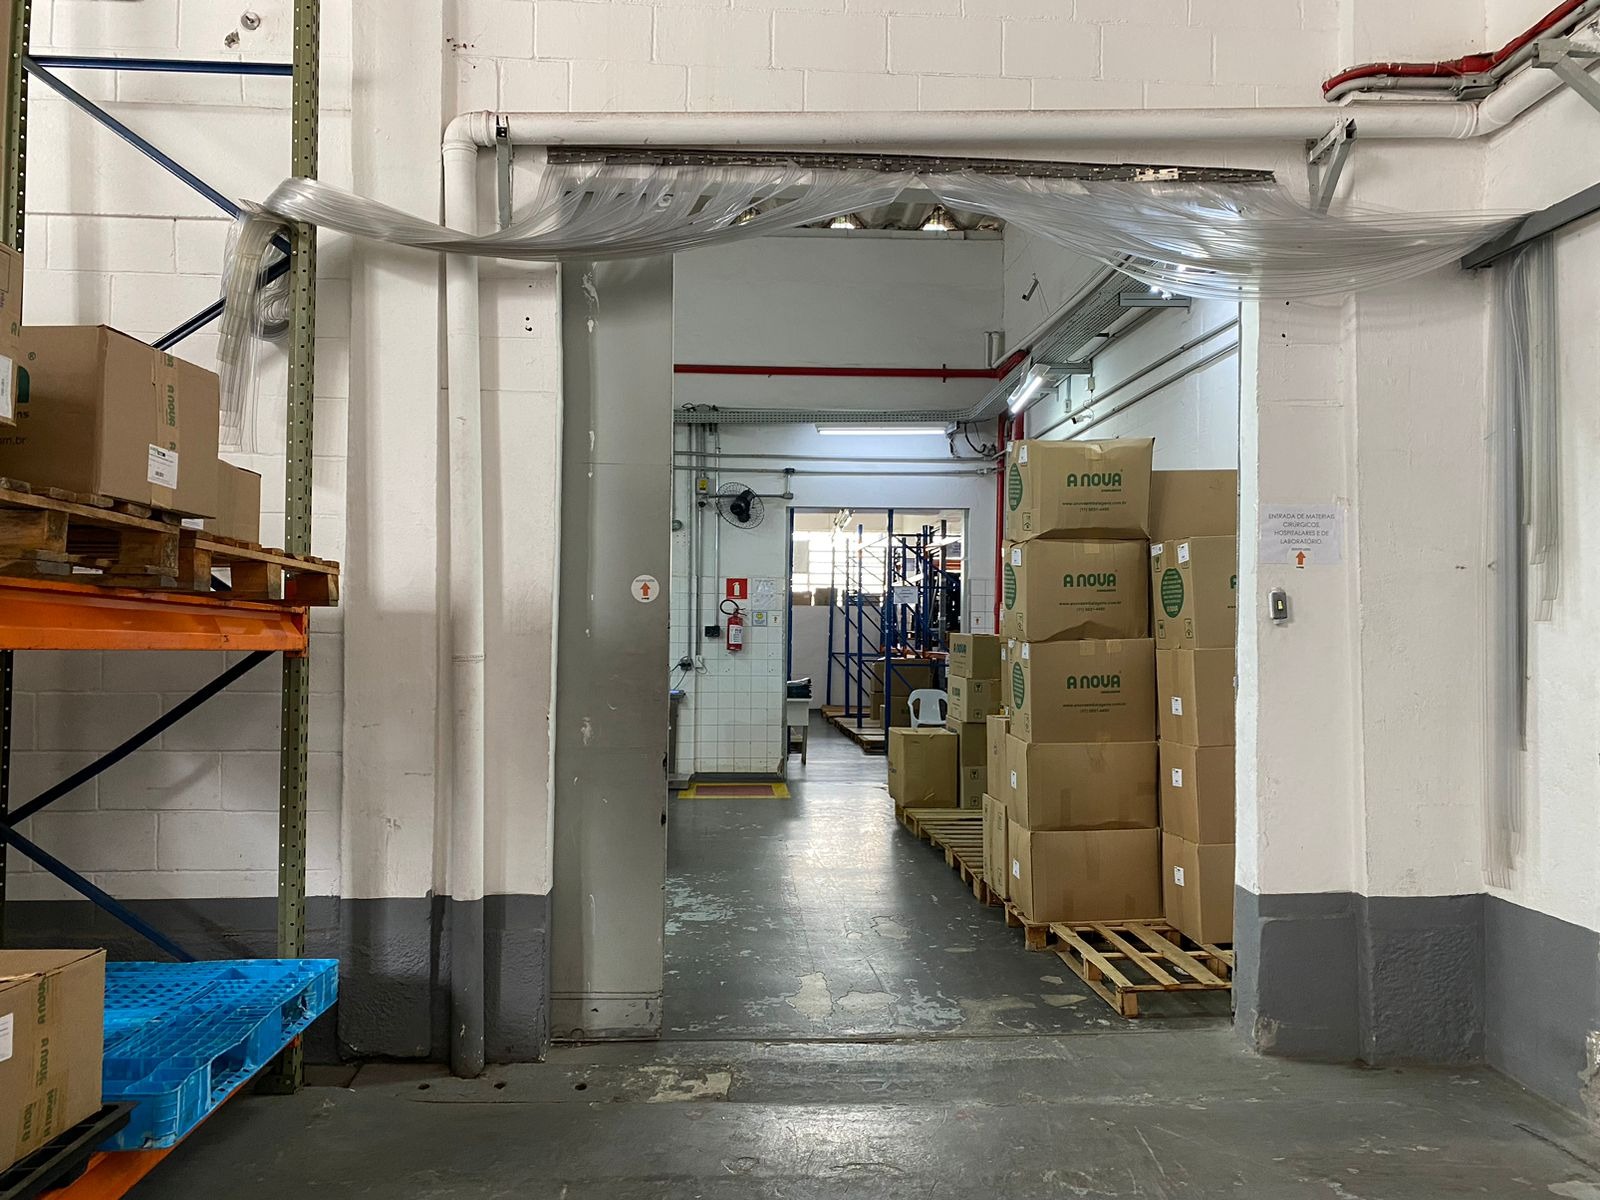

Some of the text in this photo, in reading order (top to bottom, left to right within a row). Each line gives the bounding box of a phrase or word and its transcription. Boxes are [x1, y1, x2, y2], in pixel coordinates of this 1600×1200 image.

[1067, 473, 1121, 487] A NOVA
[1064, 573, 1116, 587] A NOVA
[1067, 675, 1120, 689] A NOVA
